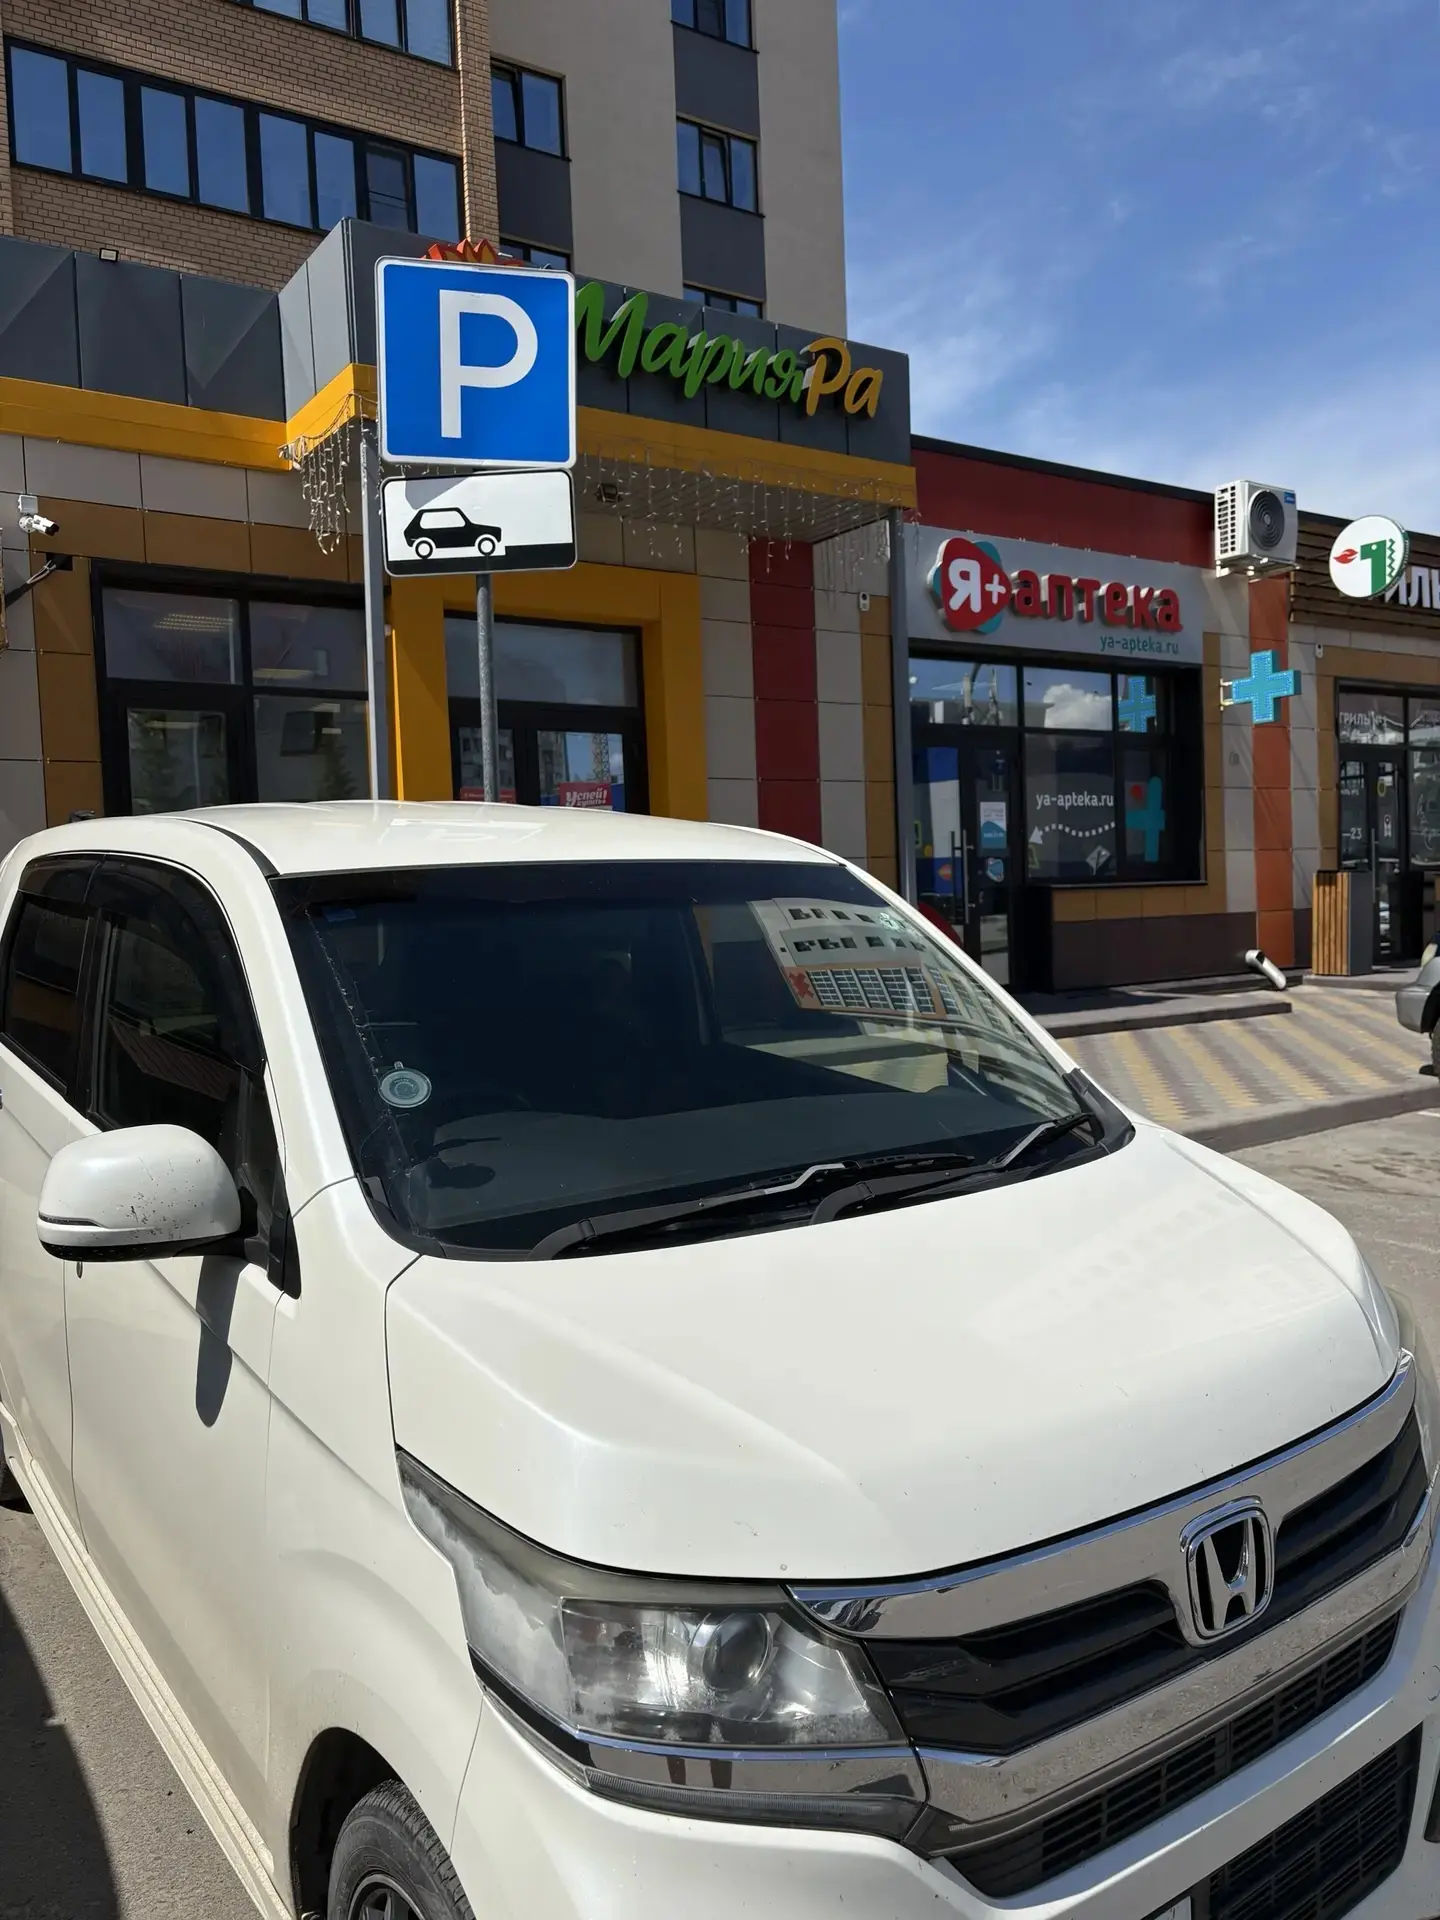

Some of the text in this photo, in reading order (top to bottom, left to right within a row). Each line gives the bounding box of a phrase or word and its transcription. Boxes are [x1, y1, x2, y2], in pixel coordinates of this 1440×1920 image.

[439, 289, 538, 439] P
[1010, 569, 1184, 633] аптека
[1100, 633, 1180, 655] ya-apteka.ru
[1036, 791, 1114, 810] ya-apteka.ru
